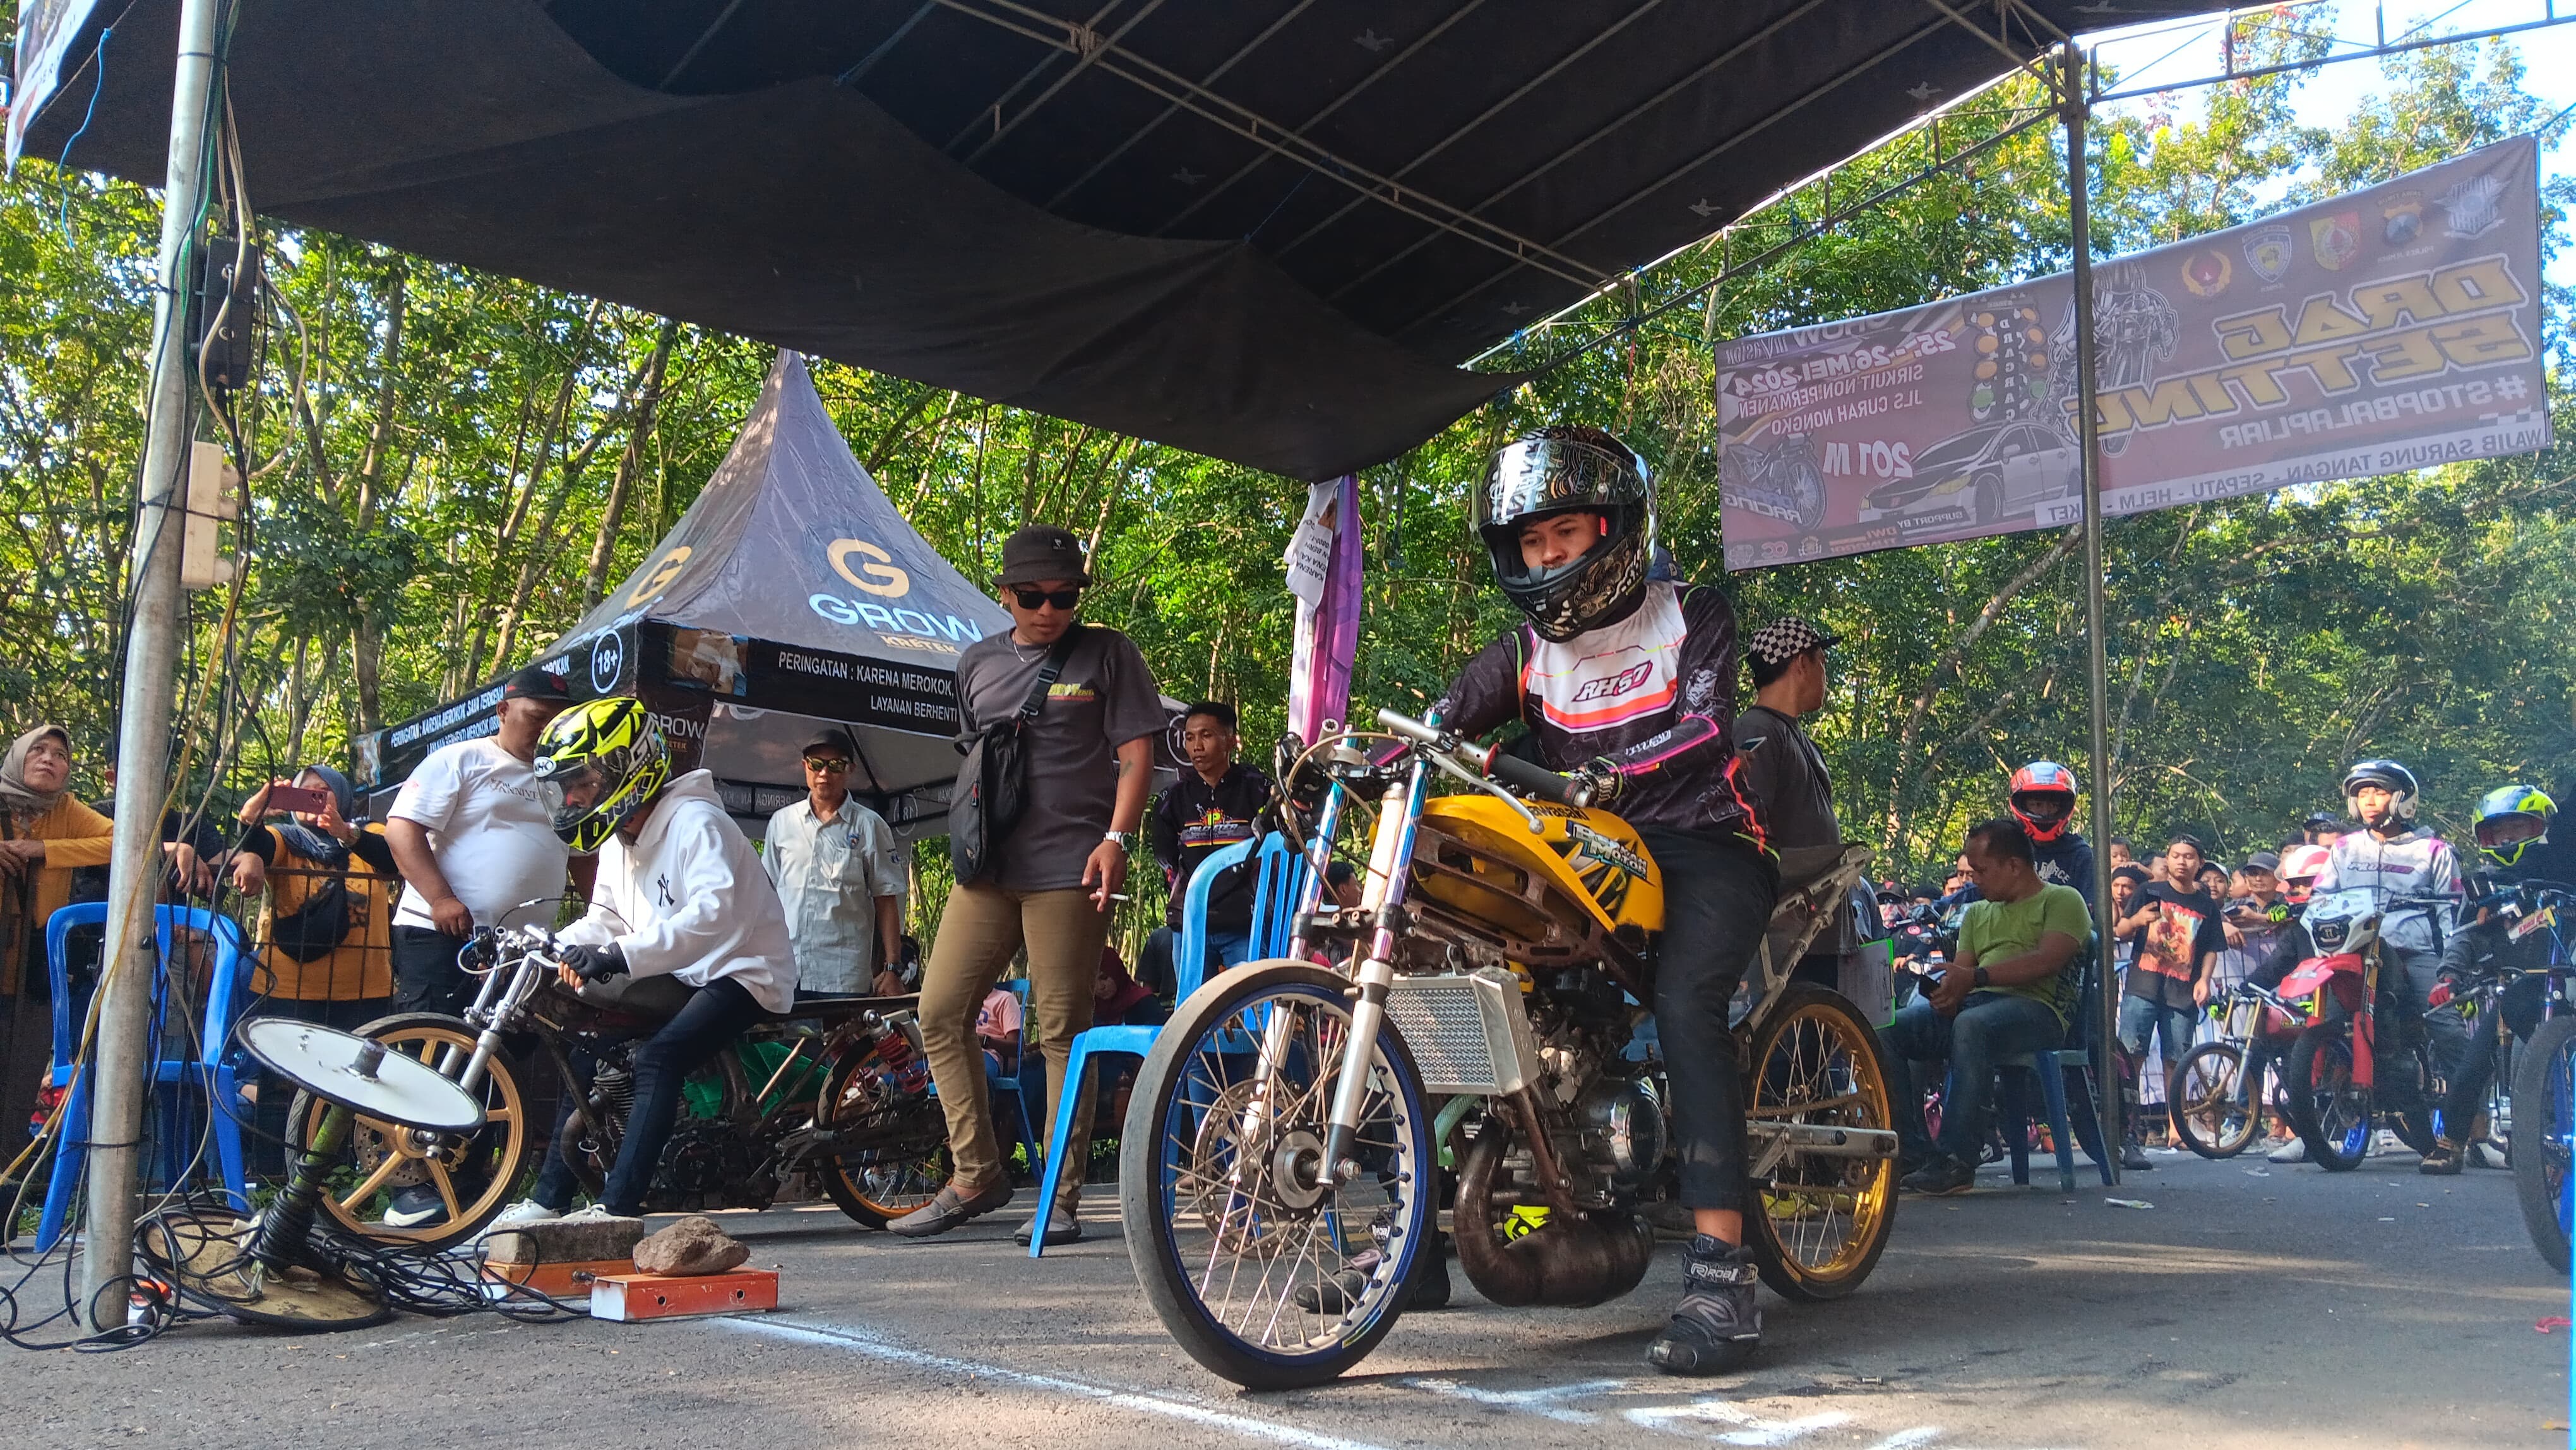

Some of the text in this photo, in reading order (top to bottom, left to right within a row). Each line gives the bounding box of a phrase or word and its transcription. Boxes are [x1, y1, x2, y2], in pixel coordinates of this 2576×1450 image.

[826, 538, 910, 599] G
[809, 593, 983, 643] GROW
[880, 634, 961, 655] KRETEK
[597, 649, 618, 676] 18+
[778, 650, 847, 679] PERINGATAN
[856, 664, 900, 688] KARENA
[901, 671, 955, 699] MEROKOK,
[871, 695, 958, 722] LAYANAN BERHENTI
[391, 722, 420, 748] PERINGATAN
[421, 716, 442, 736] KARENA
[1529, 806, 1590, 821] awasaki
